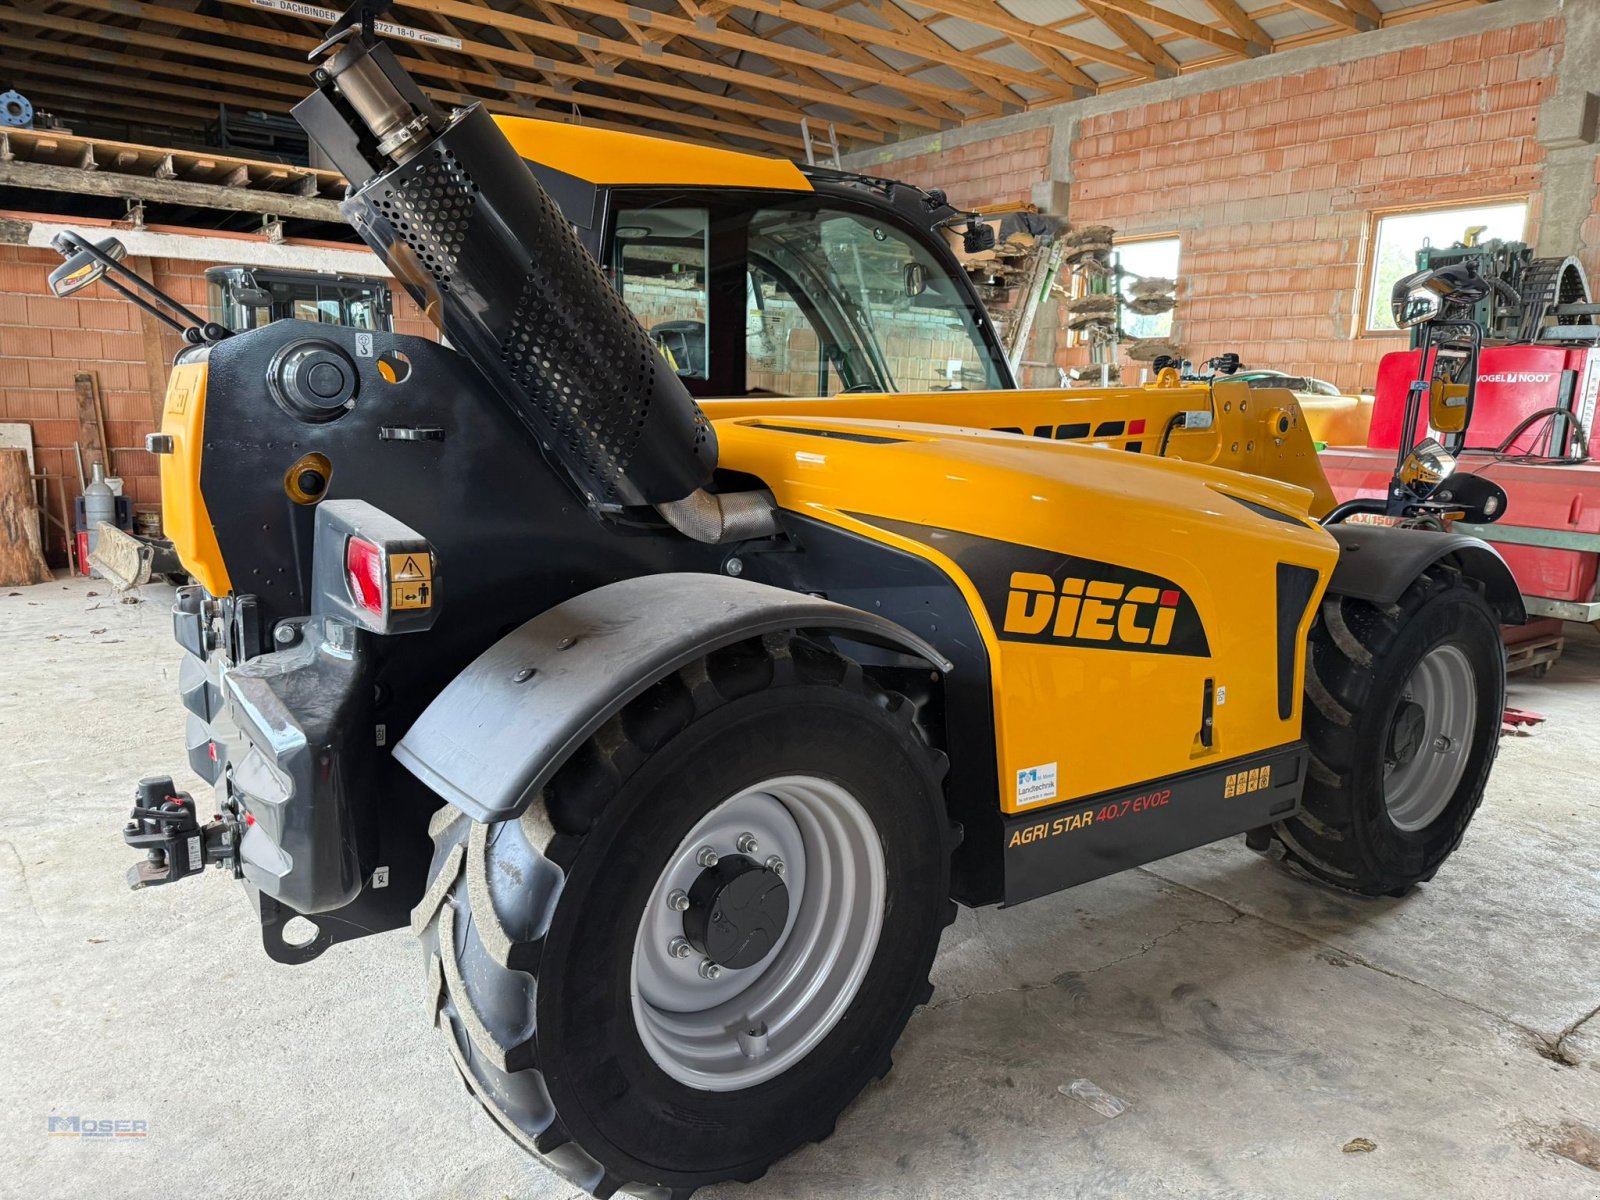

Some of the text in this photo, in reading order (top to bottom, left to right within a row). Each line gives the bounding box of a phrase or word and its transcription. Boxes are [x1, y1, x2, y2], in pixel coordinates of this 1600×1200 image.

[280, 1, 336, 20] DACHBINDER
[397, 27, 415, 38] 18-0
[1476, 374, 1551, 383] VOGEL NOOT
[1348, 514, 1369, 523] AX
[1018, 781, 1055, 796] Landtechnik
[1008, 822, 1050, 848] AGRI
[1052, 811, 1094, 836] STAR
[1096, 800, 1131, 823] 40.7
